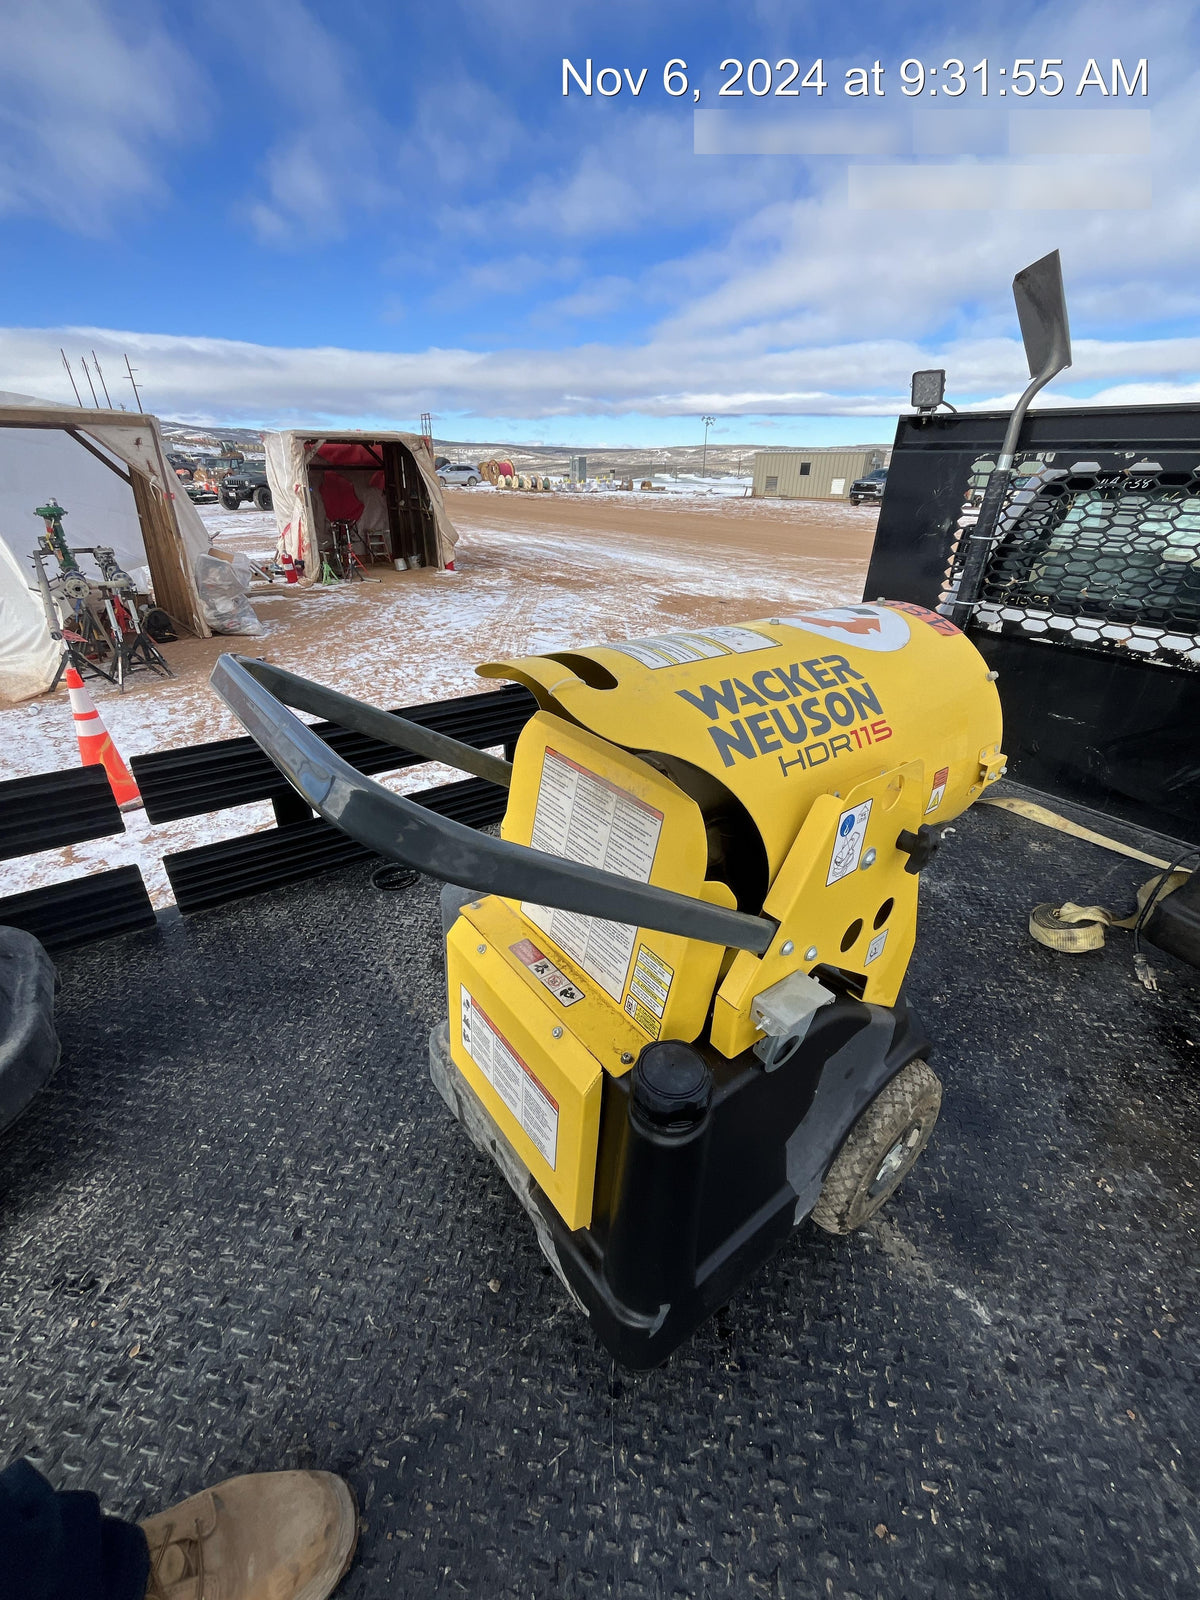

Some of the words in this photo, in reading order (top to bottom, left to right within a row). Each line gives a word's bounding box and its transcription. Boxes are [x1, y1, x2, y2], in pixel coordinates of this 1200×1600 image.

[674, 654, 865, 721] WACKER
[707, 682, 884, 768] NEUSON
[777, 719, 893, 778] HDR115
